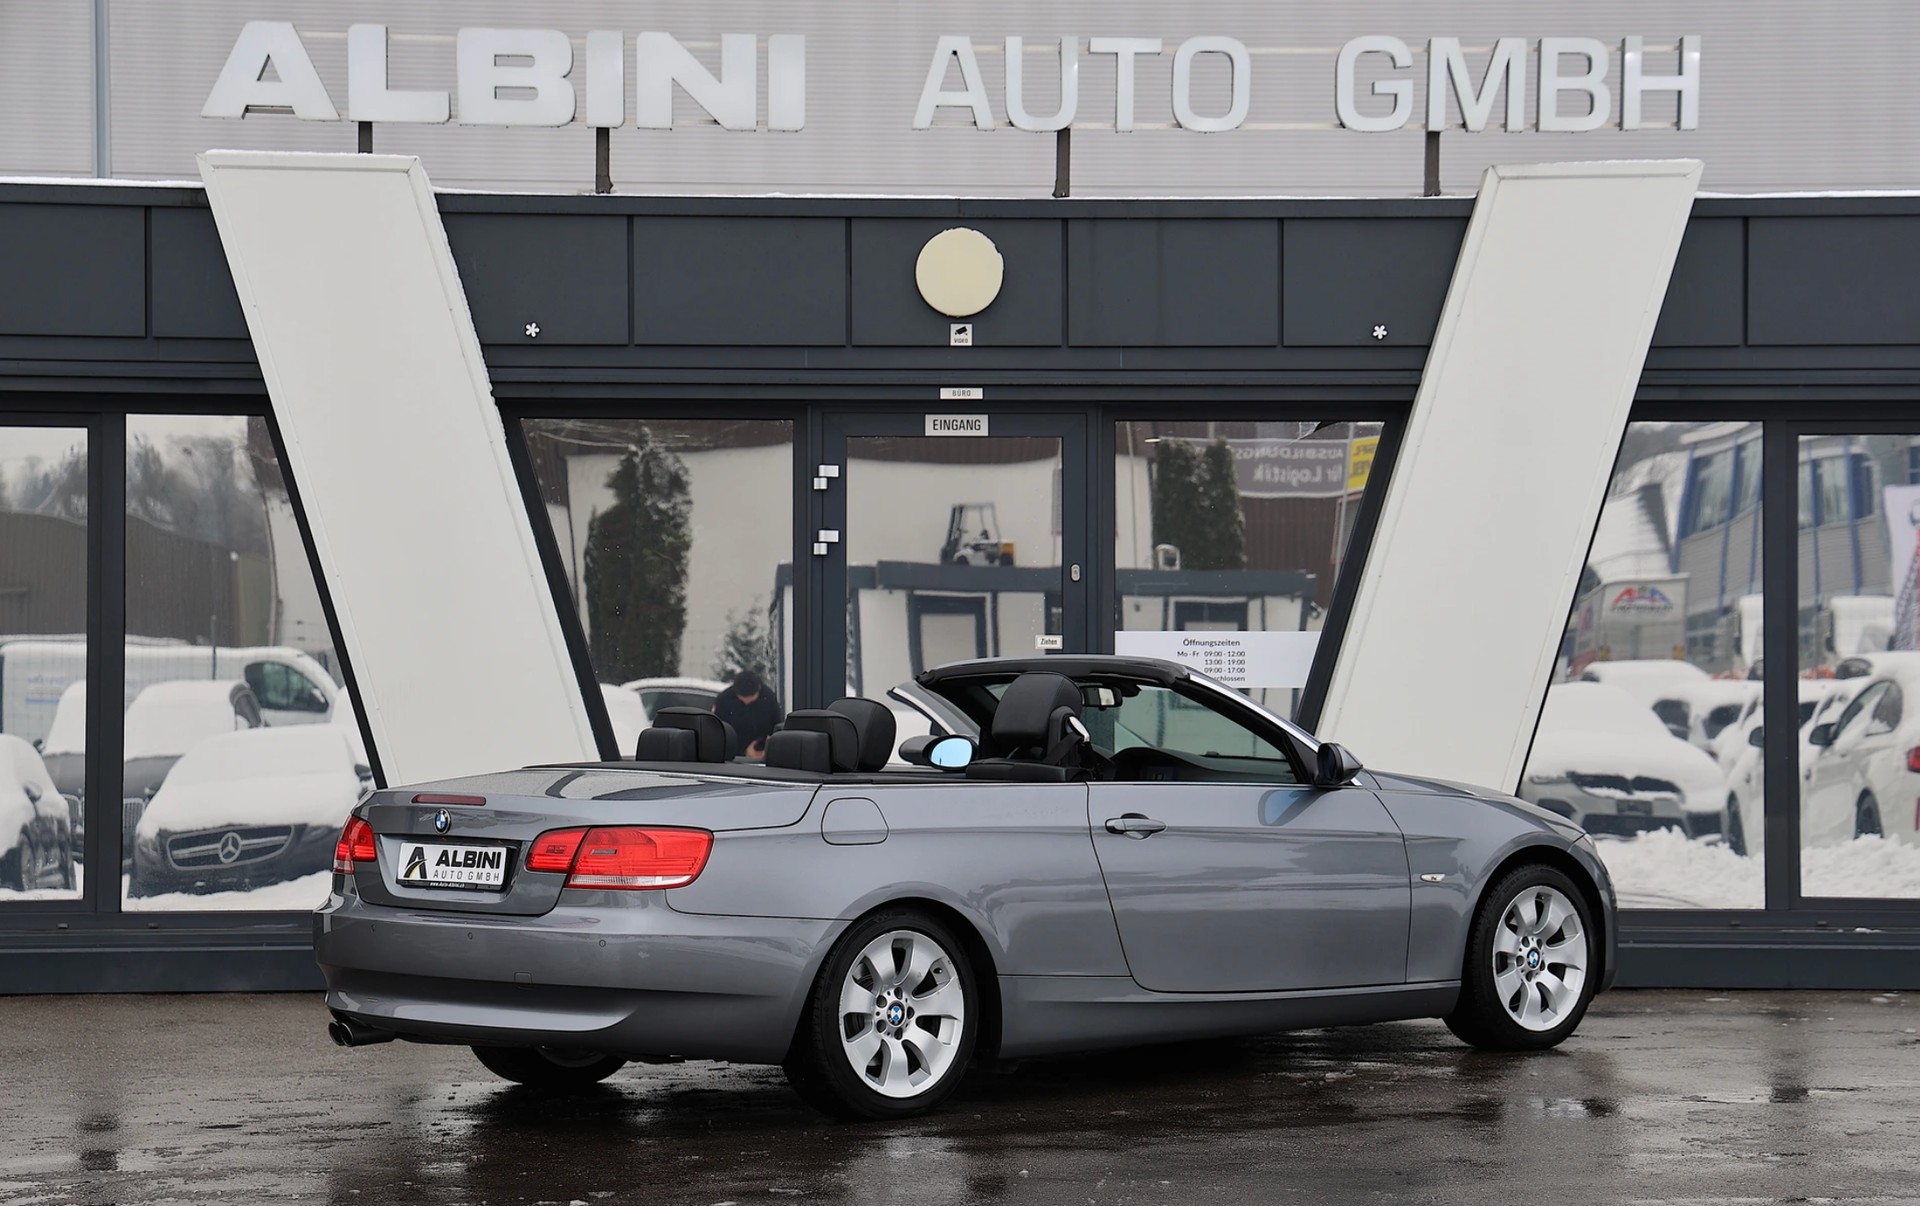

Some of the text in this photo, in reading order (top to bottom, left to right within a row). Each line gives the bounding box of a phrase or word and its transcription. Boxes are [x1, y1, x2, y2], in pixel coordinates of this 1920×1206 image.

[201, 20, 1702, 133] ALBINI AUTO GMBH
[952, 388, 972, 397] BÜRO
[932, 419, 982, 432] EINGANG
[1040, 638, 1058, 646] Ziehen
[1182, 638, 1241, 648] Öffnungszeiten
[435, 849, 502, 870] ALBINI
[433, 869, 500, 882] AUTO GMBH
